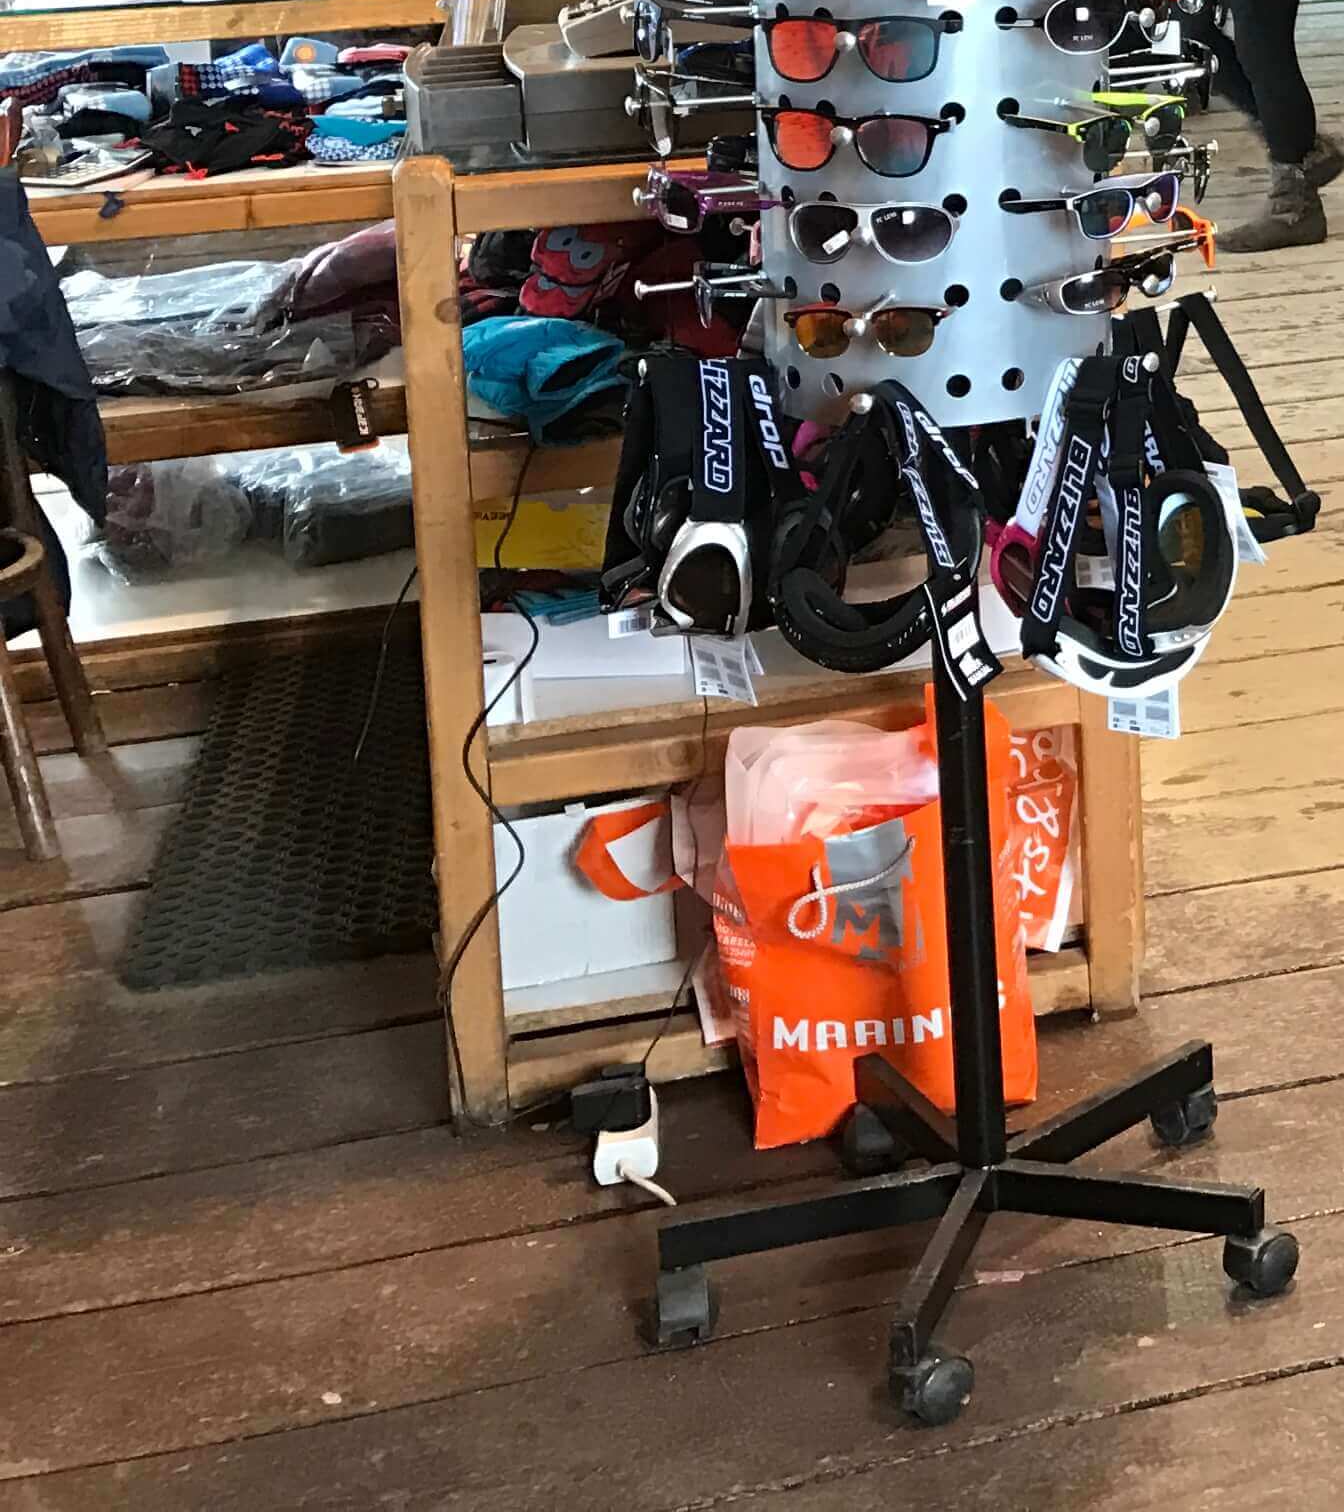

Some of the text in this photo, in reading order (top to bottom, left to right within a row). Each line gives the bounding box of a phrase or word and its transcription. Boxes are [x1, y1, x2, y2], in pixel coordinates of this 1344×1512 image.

[699, 359, 733, 493] LIZZARD
[748, 374, 790, 470] drop
[914, 410, 981, 490] drop
[1030, 434, 1093, 624] BLIZZARD
[1117, 486, 1144, 657] BLIZZARD
